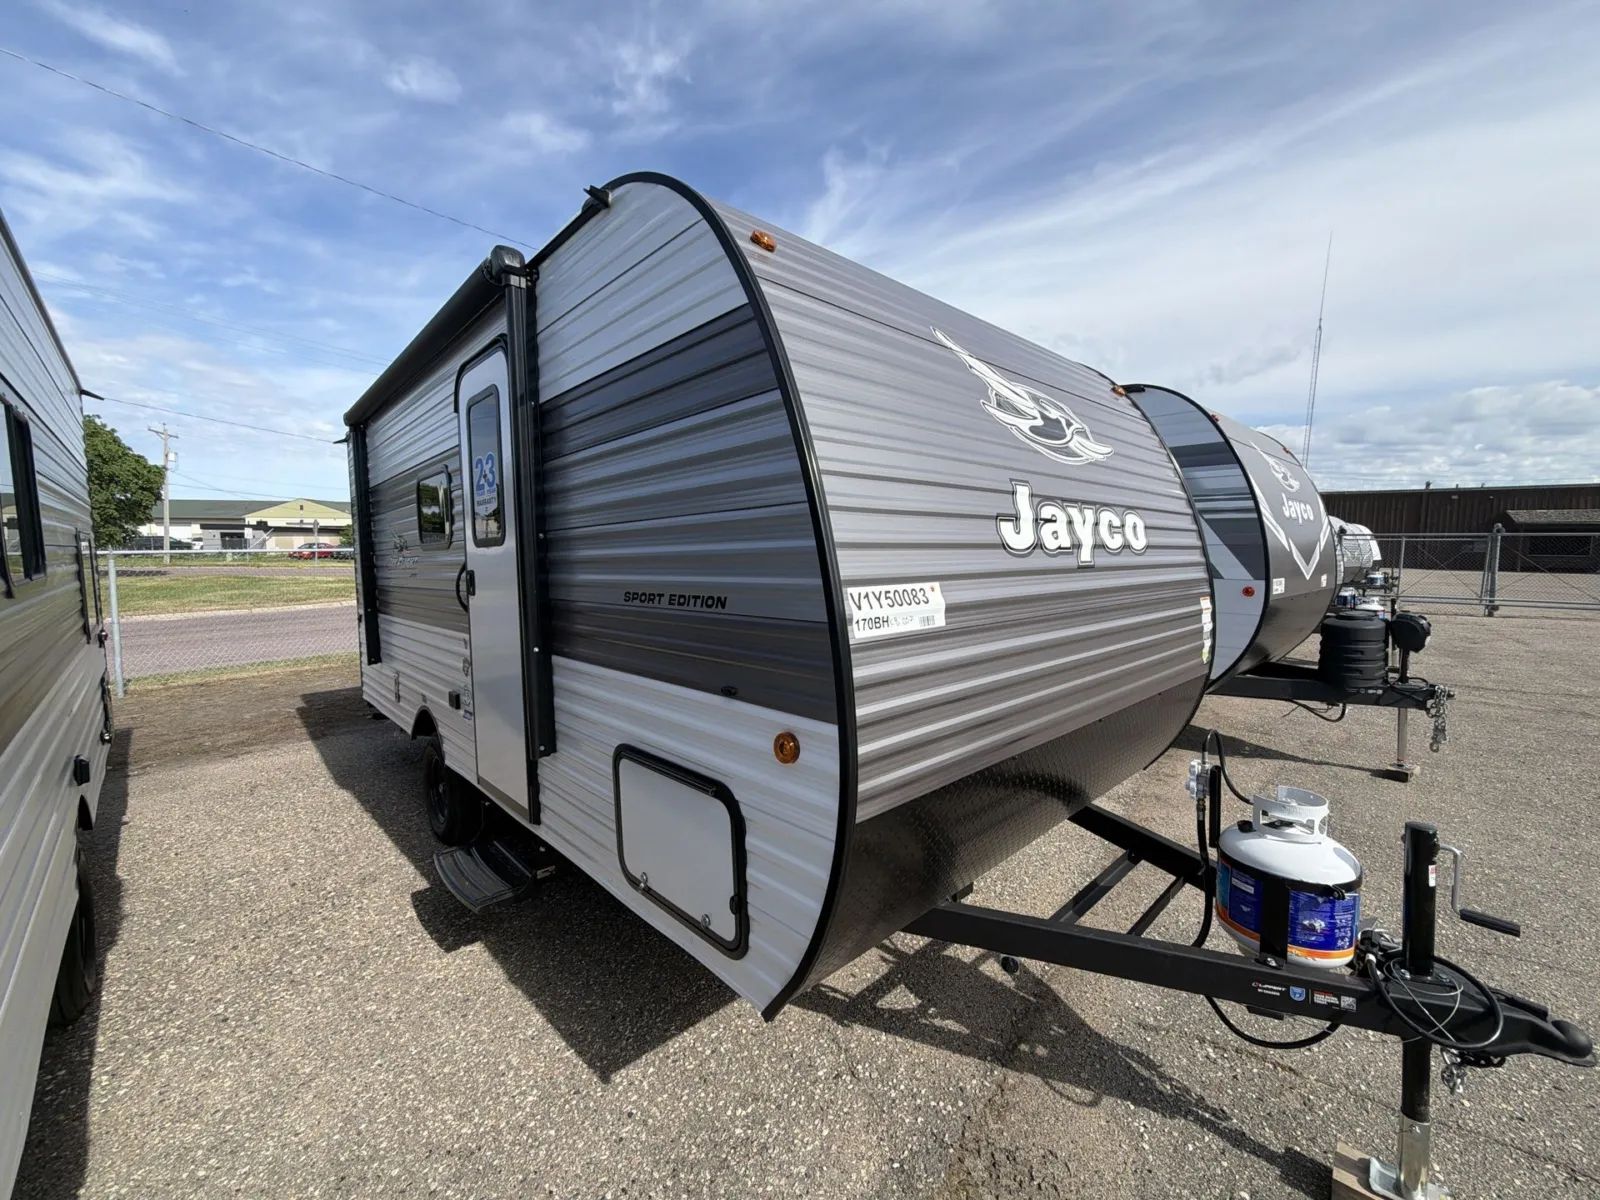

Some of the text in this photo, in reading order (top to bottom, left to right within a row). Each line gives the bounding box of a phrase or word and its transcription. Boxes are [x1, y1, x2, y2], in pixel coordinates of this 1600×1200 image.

[1281, 491, 1315, 525] Jayco
[996, 480, 1149, 567] Jayco
[623, 591, 728, 610] SPORT EDITION
[849, 588, 930, 611] V1Y50083
[854, 616, 890, 632] 170BH
